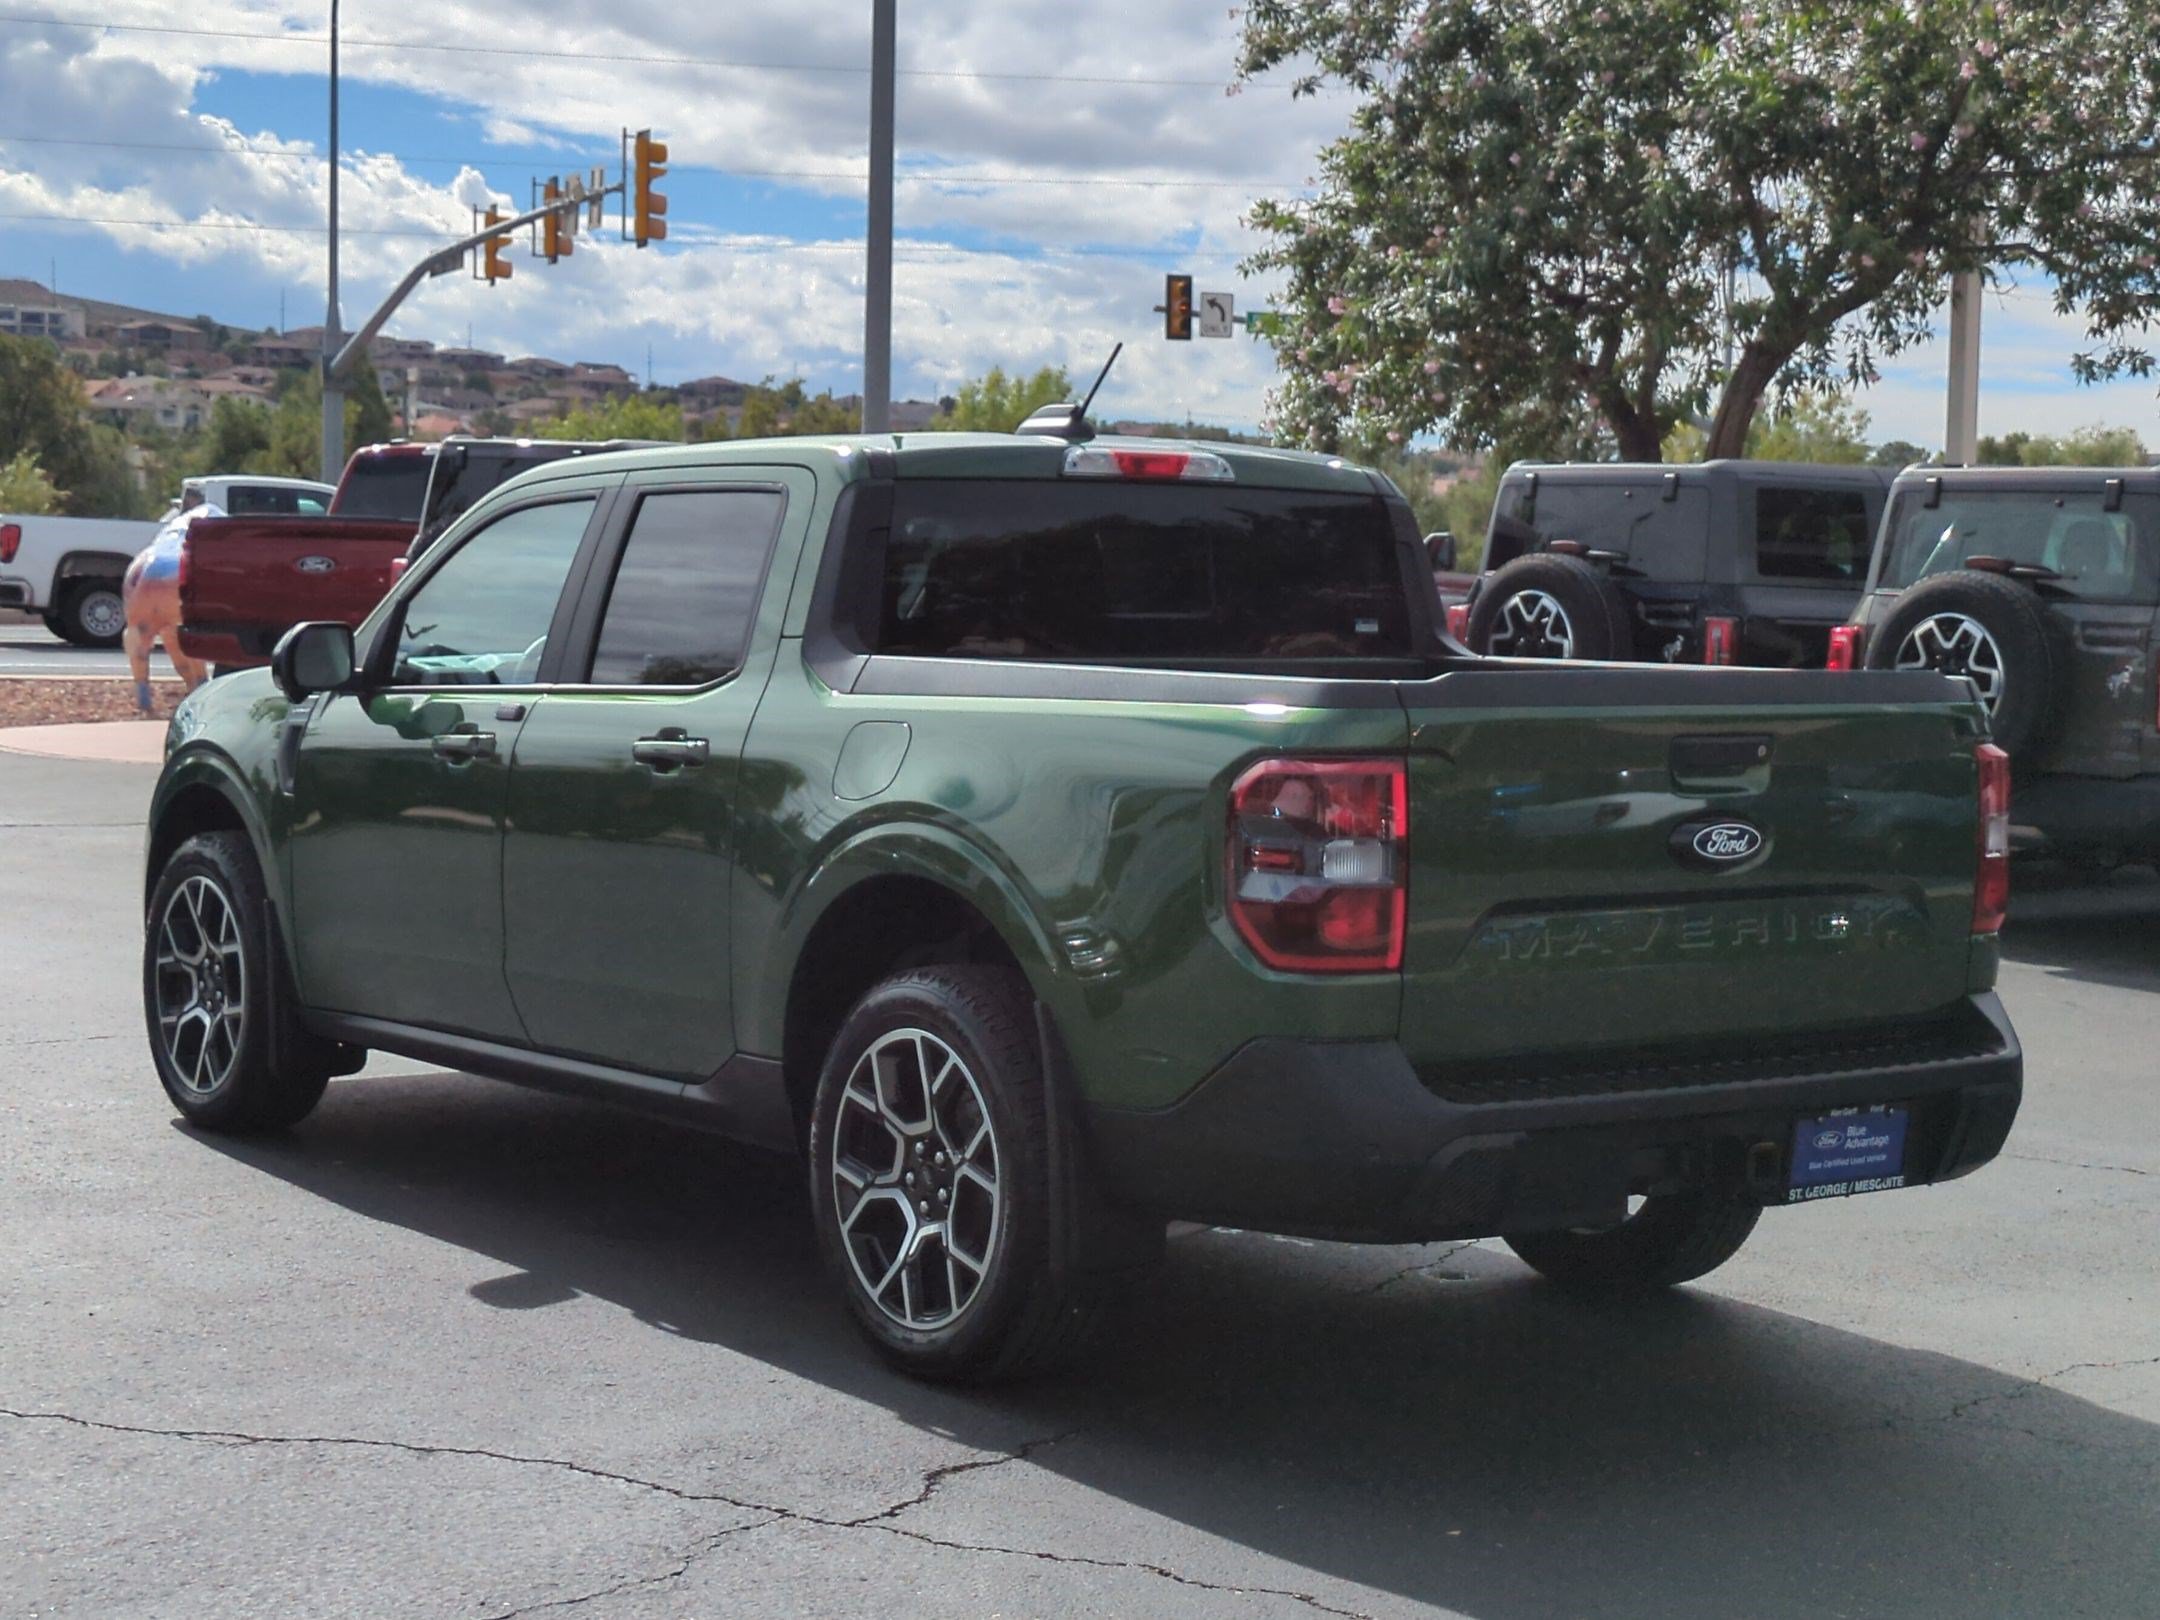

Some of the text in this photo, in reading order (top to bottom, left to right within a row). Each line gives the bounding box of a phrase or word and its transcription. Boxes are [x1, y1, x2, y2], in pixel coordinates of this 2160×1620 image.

[1707, 829, 1749, 853] Ford
[1847, 1126, 1867, 1137] Blue
[1819, 1134, 1838, 1145] Ford
[1844, 1135, 1889, 1149] Advantage
[1788, 1189, 1803, 1200] ST.
[1805, 1183, 1847, 1198] GEORGE
[1855, 1176, 1904, 1191] MESQUITE
